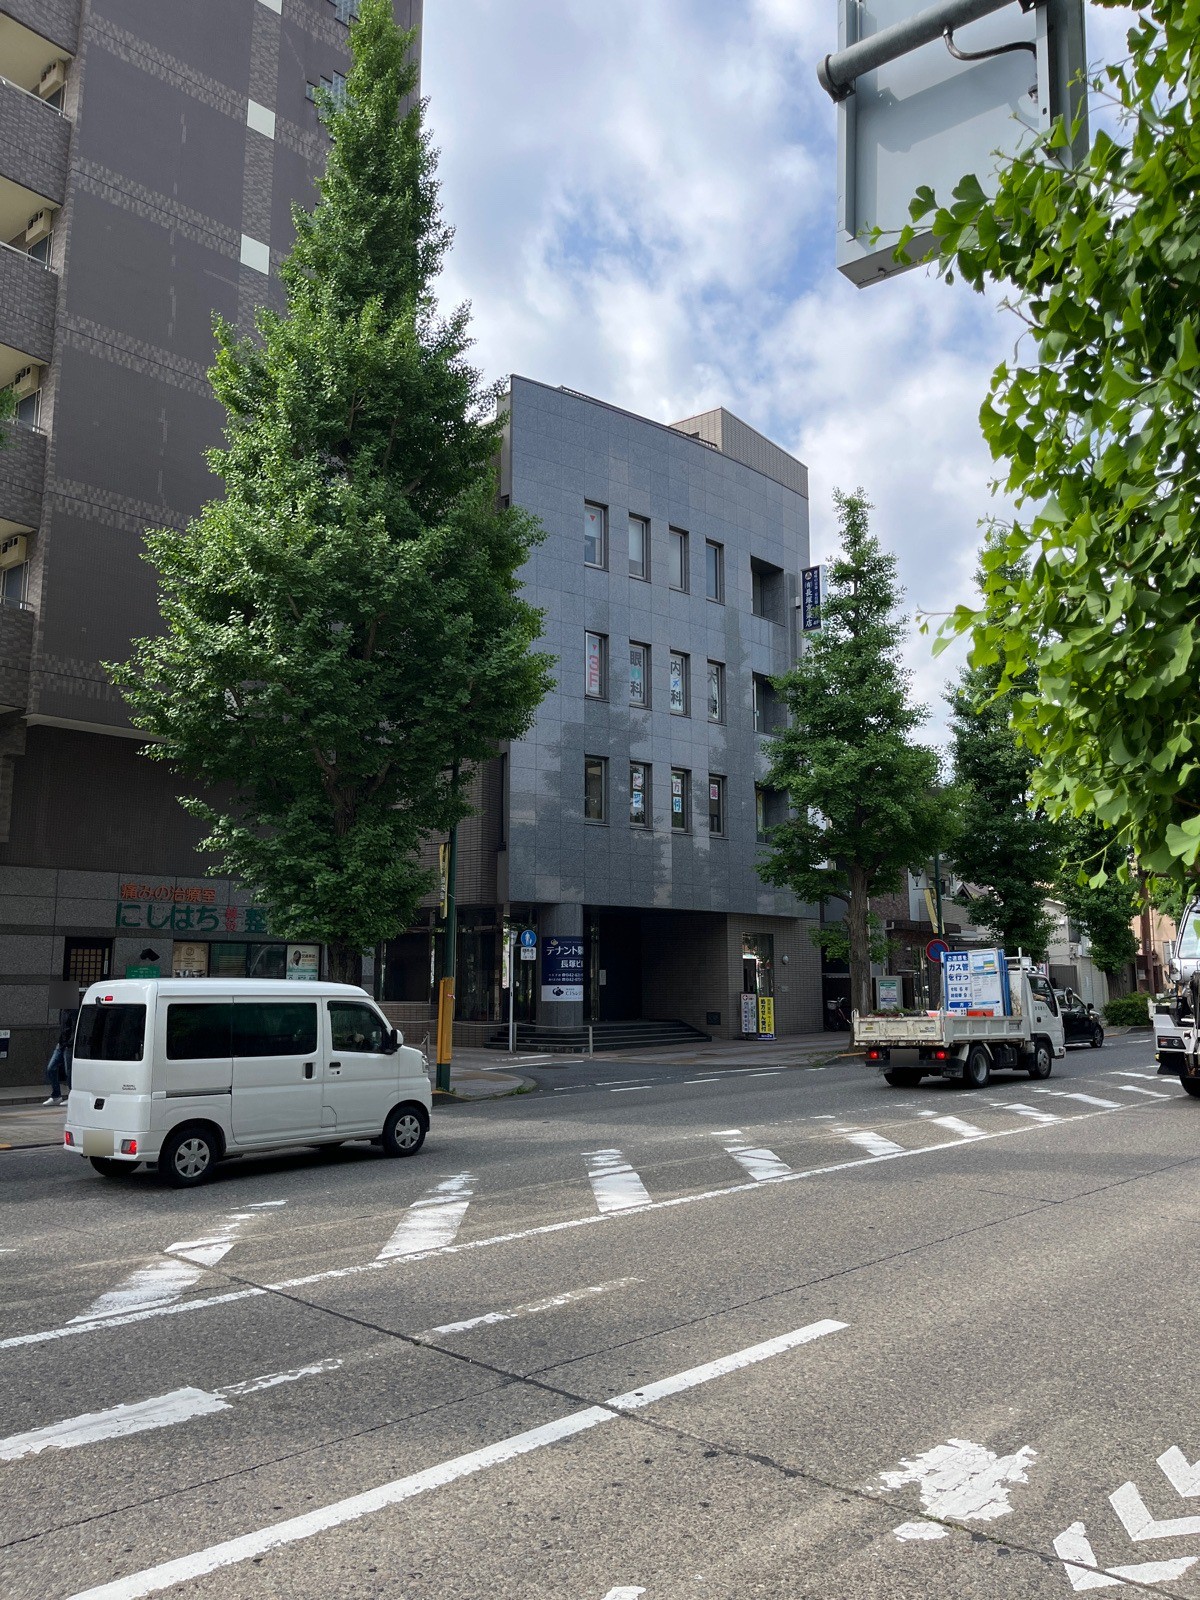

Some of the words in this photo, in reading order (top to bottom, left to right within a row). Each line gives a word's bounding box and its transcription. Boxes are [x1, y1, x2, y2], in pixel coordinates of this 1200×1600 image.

[589, 654, 599, 688] 3F
[121, 883, 216, 904] 痛みの治療室
[116, 902, 220, 932] にしはち
[949, 963, 969, 971] ガス管
